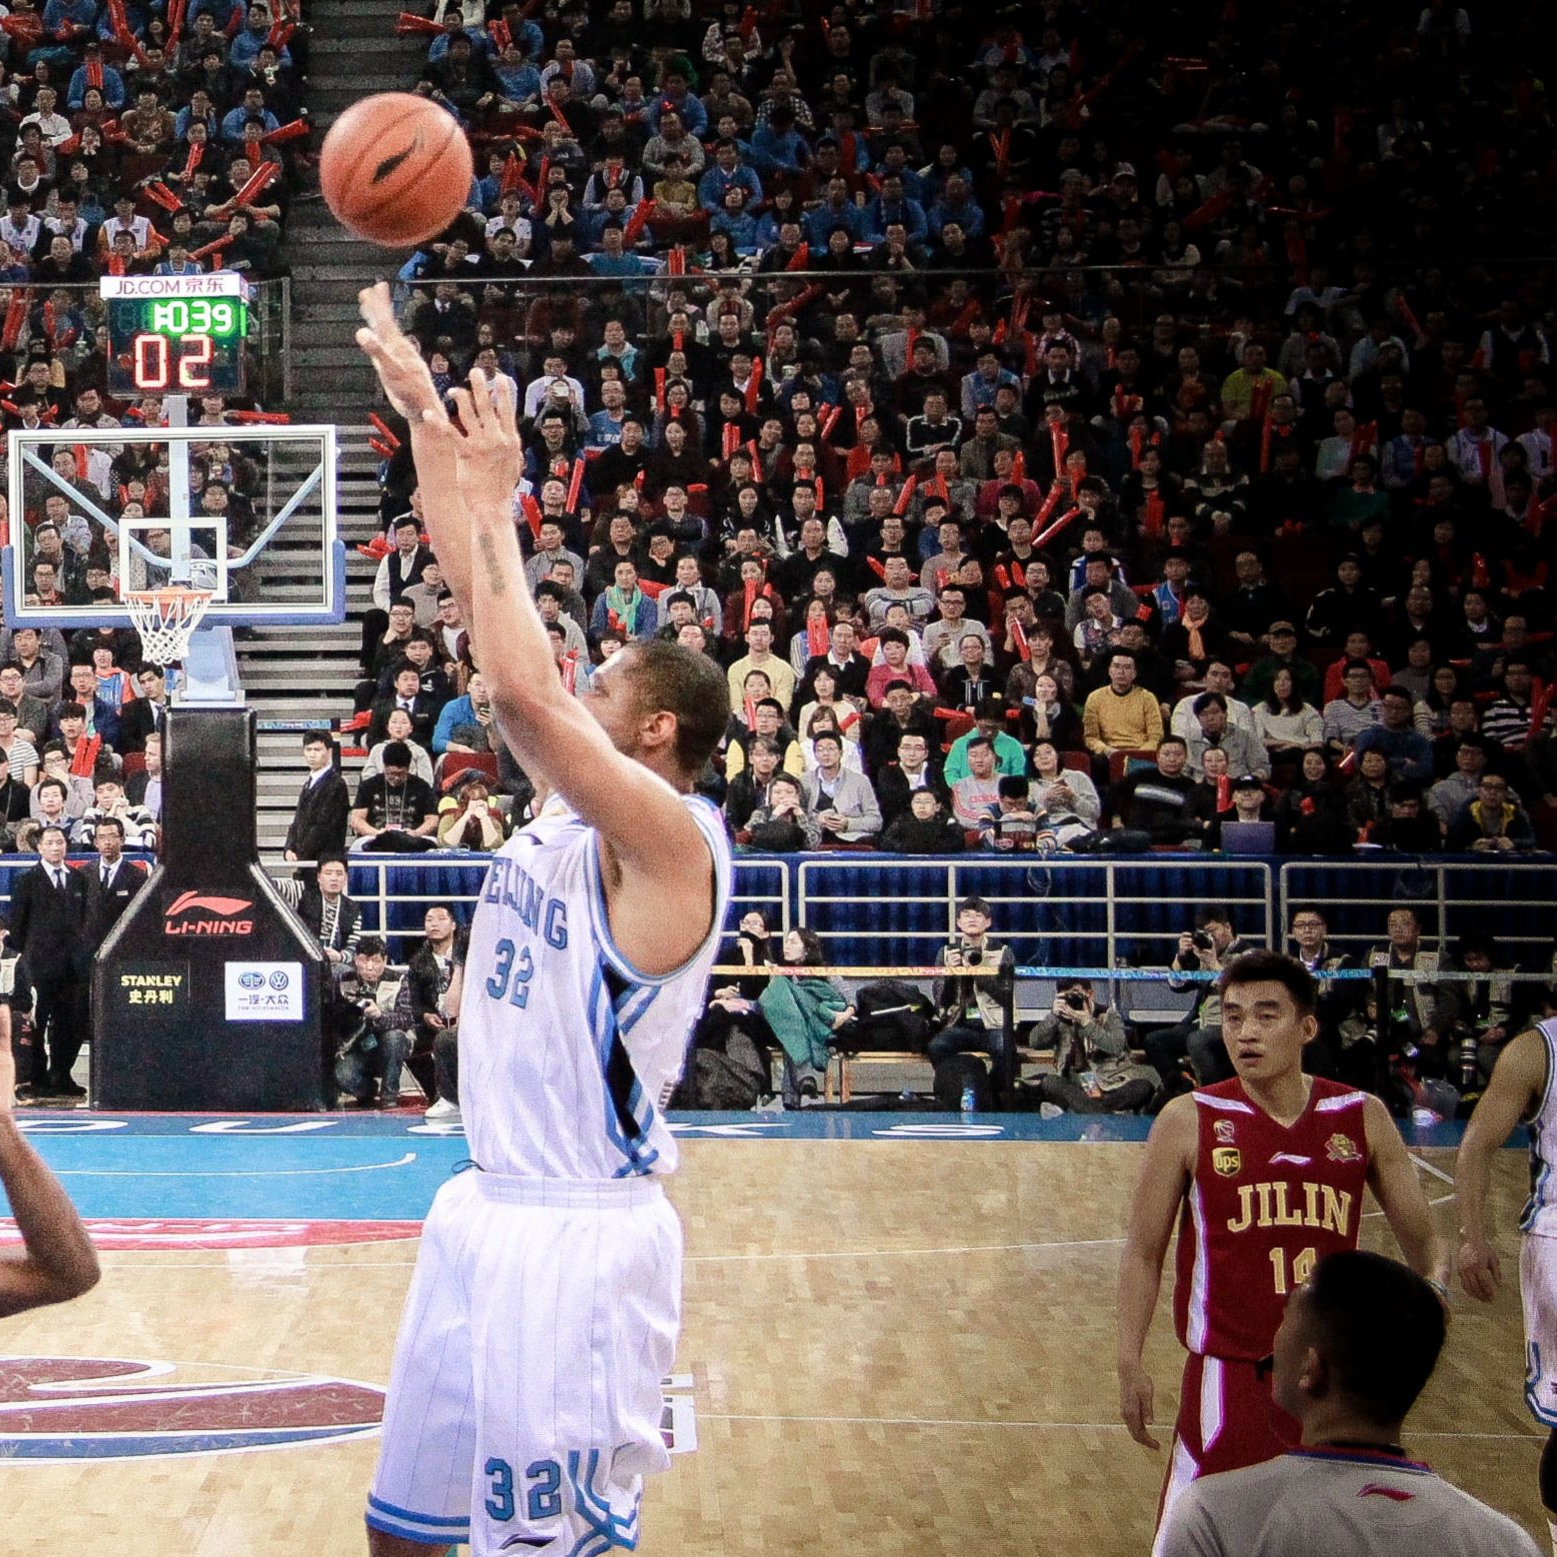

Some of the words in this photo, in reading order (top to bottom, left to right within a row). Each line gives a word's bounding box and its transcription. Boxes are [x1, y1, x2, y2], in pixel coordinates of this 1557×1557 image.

[115, 280, 180, 295] JD.COM
[185, 278, 224, 293] 京东
[135, 333, 213, 389] 02
[485, 857, 568, 950] EIJING
[164, 920, 253, 935] LI-NING
[120, 974, 182, 987] STANLEY
[486, 937, 535, 1010] 32
[129, 989, 173, 1005] 史丹利
[1215, 1155, 1239, 1173] ups
[1226, 1181, 1352, 1237] JILIN
[484, 1456, 562, 1522] 32
